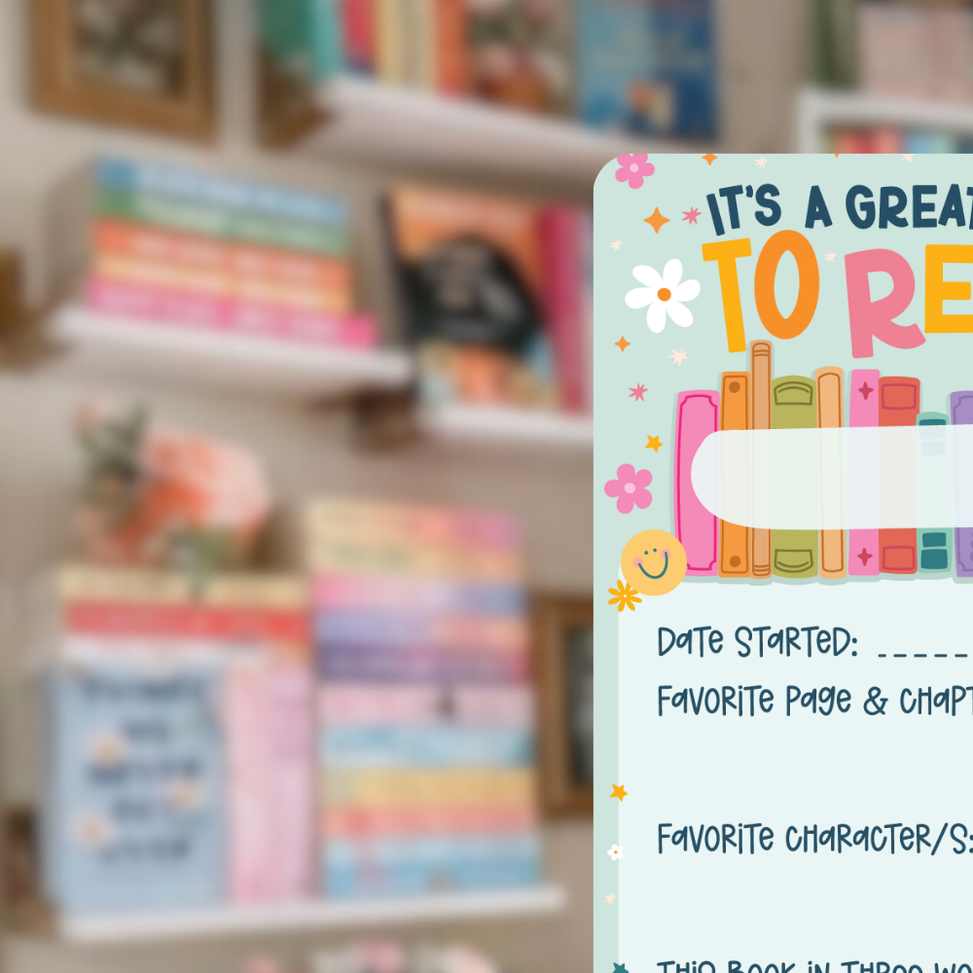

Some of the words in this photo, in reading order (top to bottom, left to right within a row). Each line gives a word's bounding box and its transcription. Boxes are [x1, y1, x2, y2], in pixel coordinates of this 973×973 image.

[706, 183, 782, 236] IT'S
[804, 185, 833, 229] A
[701, 229, 820, 353] TO
[863, 686, 889, 716] &
